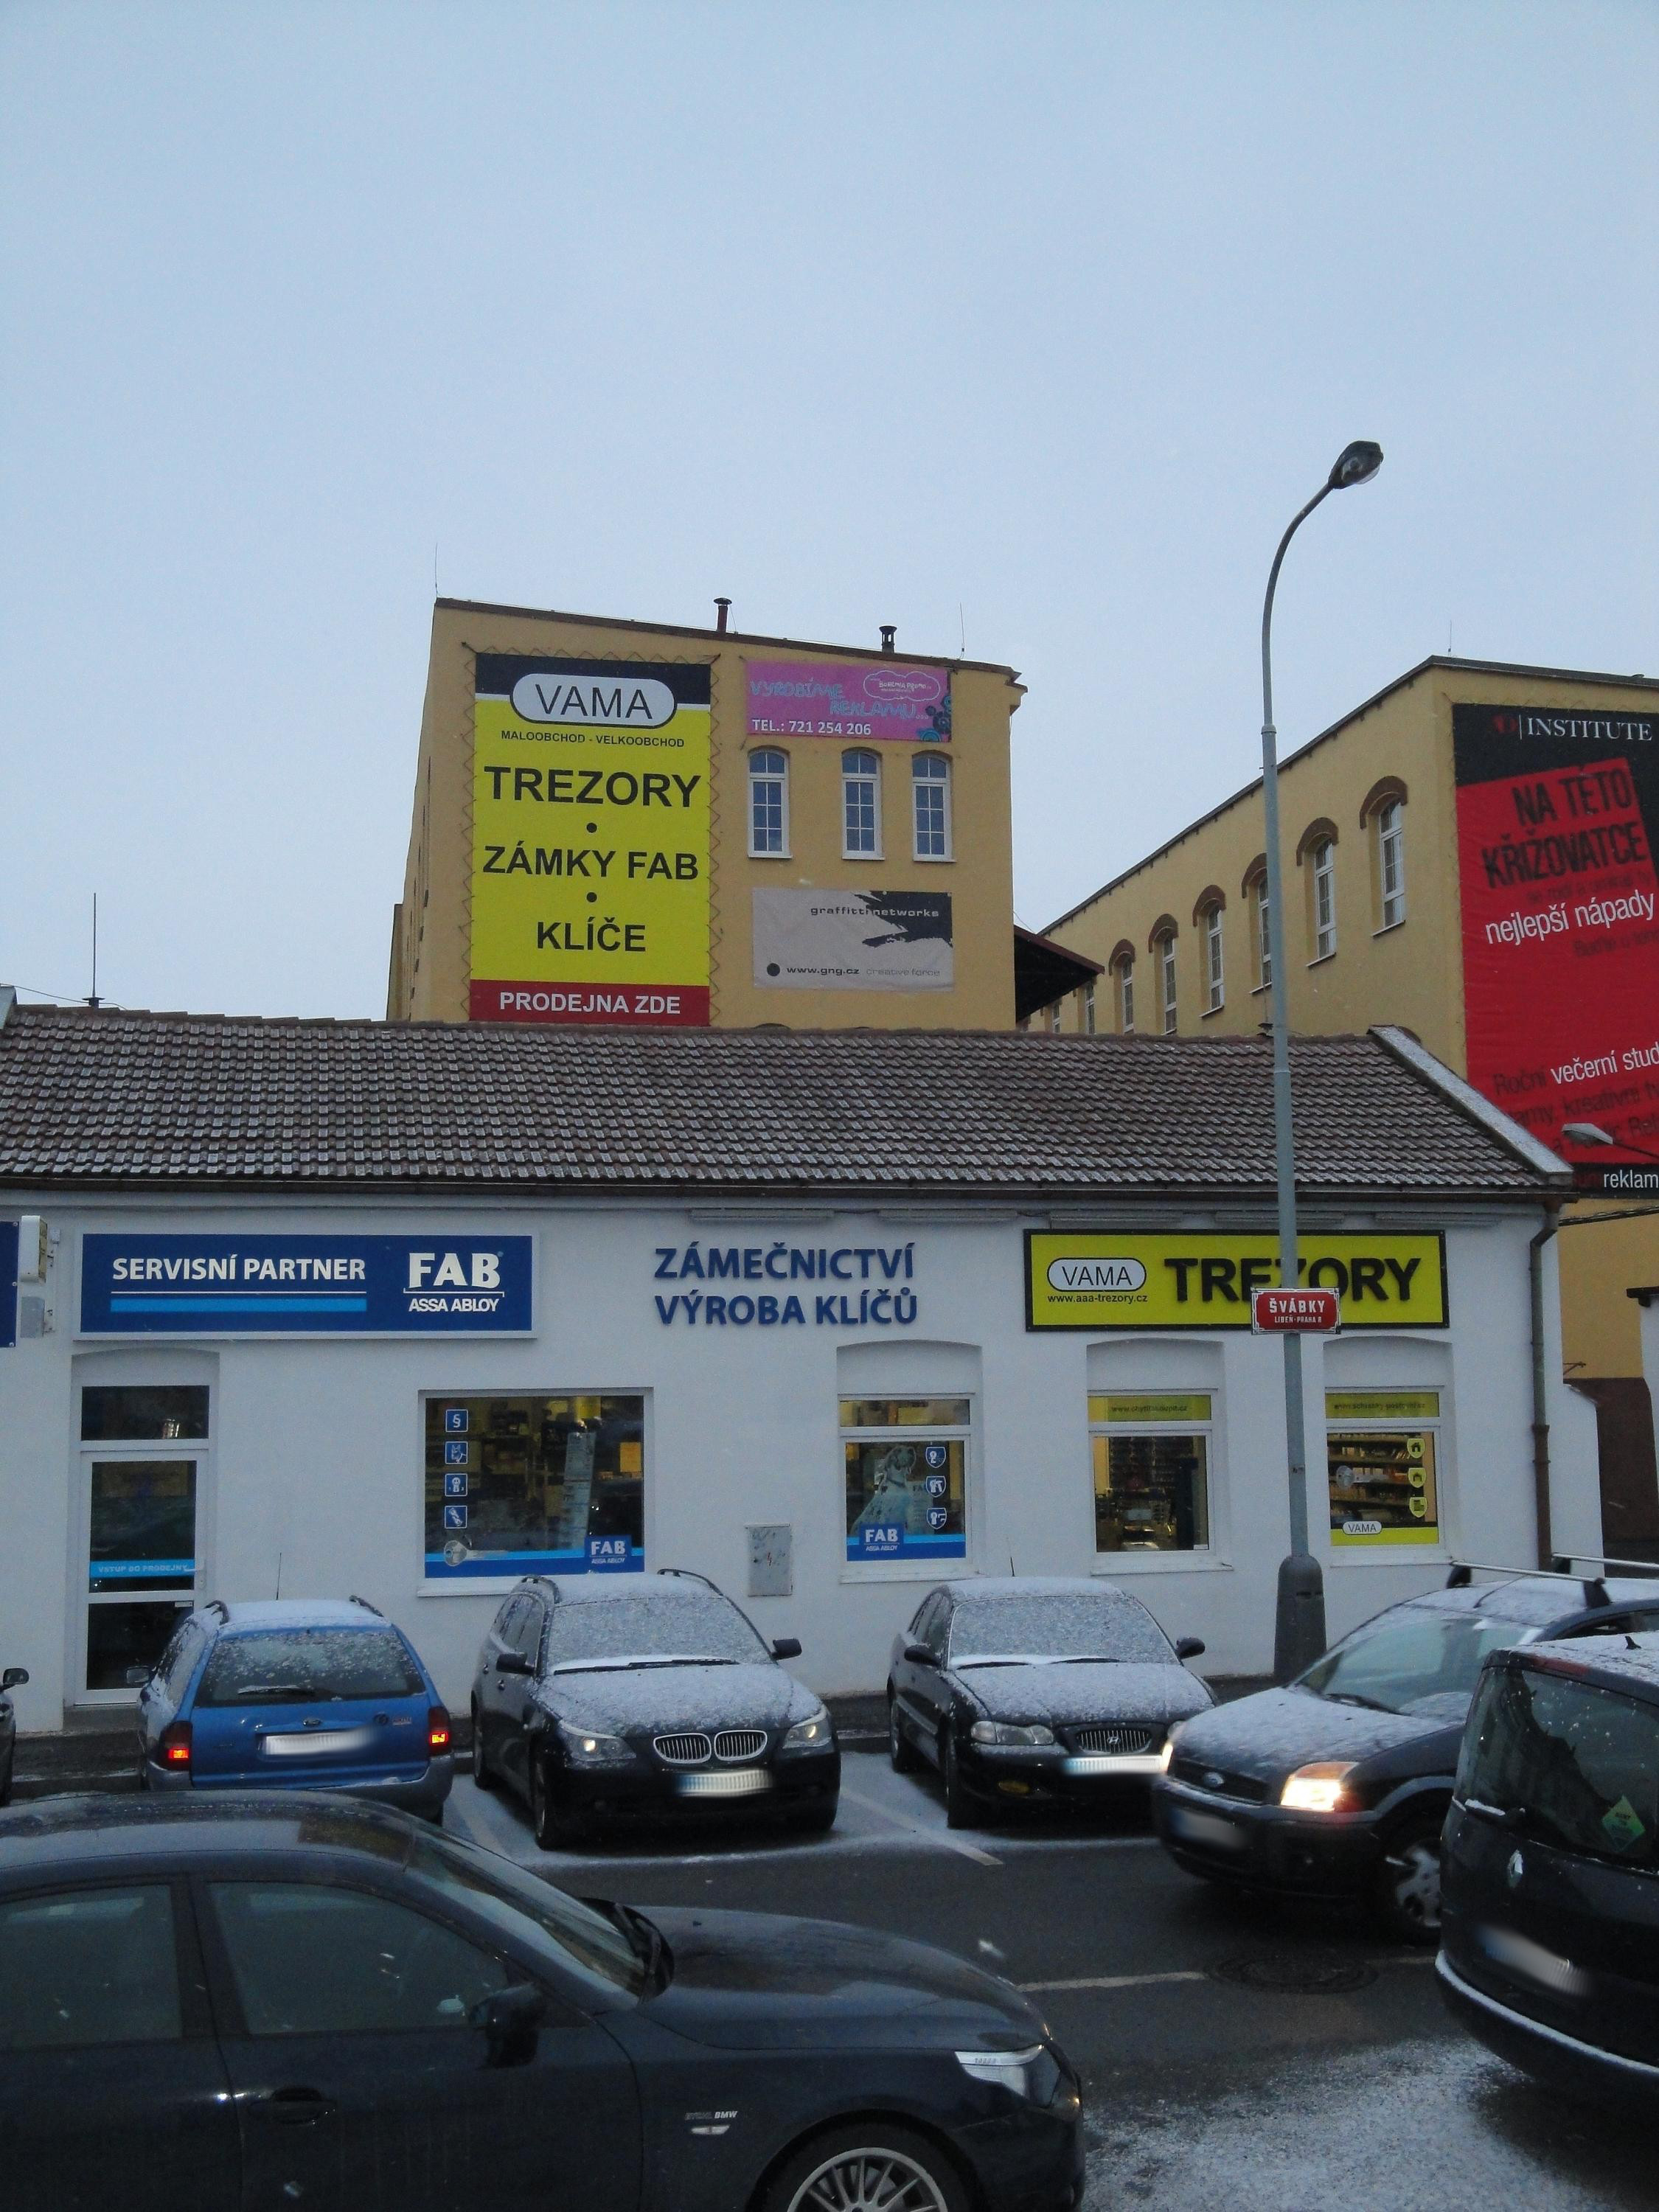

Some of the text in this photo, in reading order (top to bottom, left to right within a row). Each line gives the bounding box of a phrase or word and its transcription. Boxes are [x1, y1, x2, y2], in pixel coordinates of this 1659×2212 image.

[535, 684, 653, 720] VAMA
[501, 730, 586, 744] MALOOBCHOD
[595, 734, 684, 748] VELKOOBCHOD
[752, 719, 872, 736] TEL.: 721 254 206
[1527, 717, 1653, 741] INSTITUTE
[484, 765, 701, 807] TREZORY
[1512, 766, 1632, 827] NA TÉTO
[483, 840, 699, 880] ZÁMKY FAB
[1481, 821, 1647, 889] KŘIŽOVATCE
[1485, 902, 1570, 945] nejlepší
[1574, 889, 1655, 928] nápady
[536, 917, 647, 952] KLÍČE
[787, 967, 860, 976] www.gng.cz
[499, 992, 681, 1015] PRODEJNA ZDE
[1550, 1050, 1618, 1085] večerní
[112, 1253, 366, 1281] SERVISNÍ PARTNER
[408, 1253, 501, 1289] FAB
[654, 1241, 916, 1279] ZÁMEČNICTVÍ
[1062, 1266, 1133, 1286] VAMA
[1164, 1257, 1422, 1303] TREORY
[408, 1298, 499, 1312] ASSA ABLOY
[655, 1287, 917, 1325] VÝROBA KLÍČŮ
[1048, 1294, 1148, 1304] www.aaa-trezory.cz
[1269, 1298, 1325, 1313] ŠVÁBKY
[866, 1528, 898, 1543] FAB
[1348, 1523, 1377, 1533] VAMA
[591, 1541, 625, 1556] FAB
[714, 2110, 738, 2118] BMW
